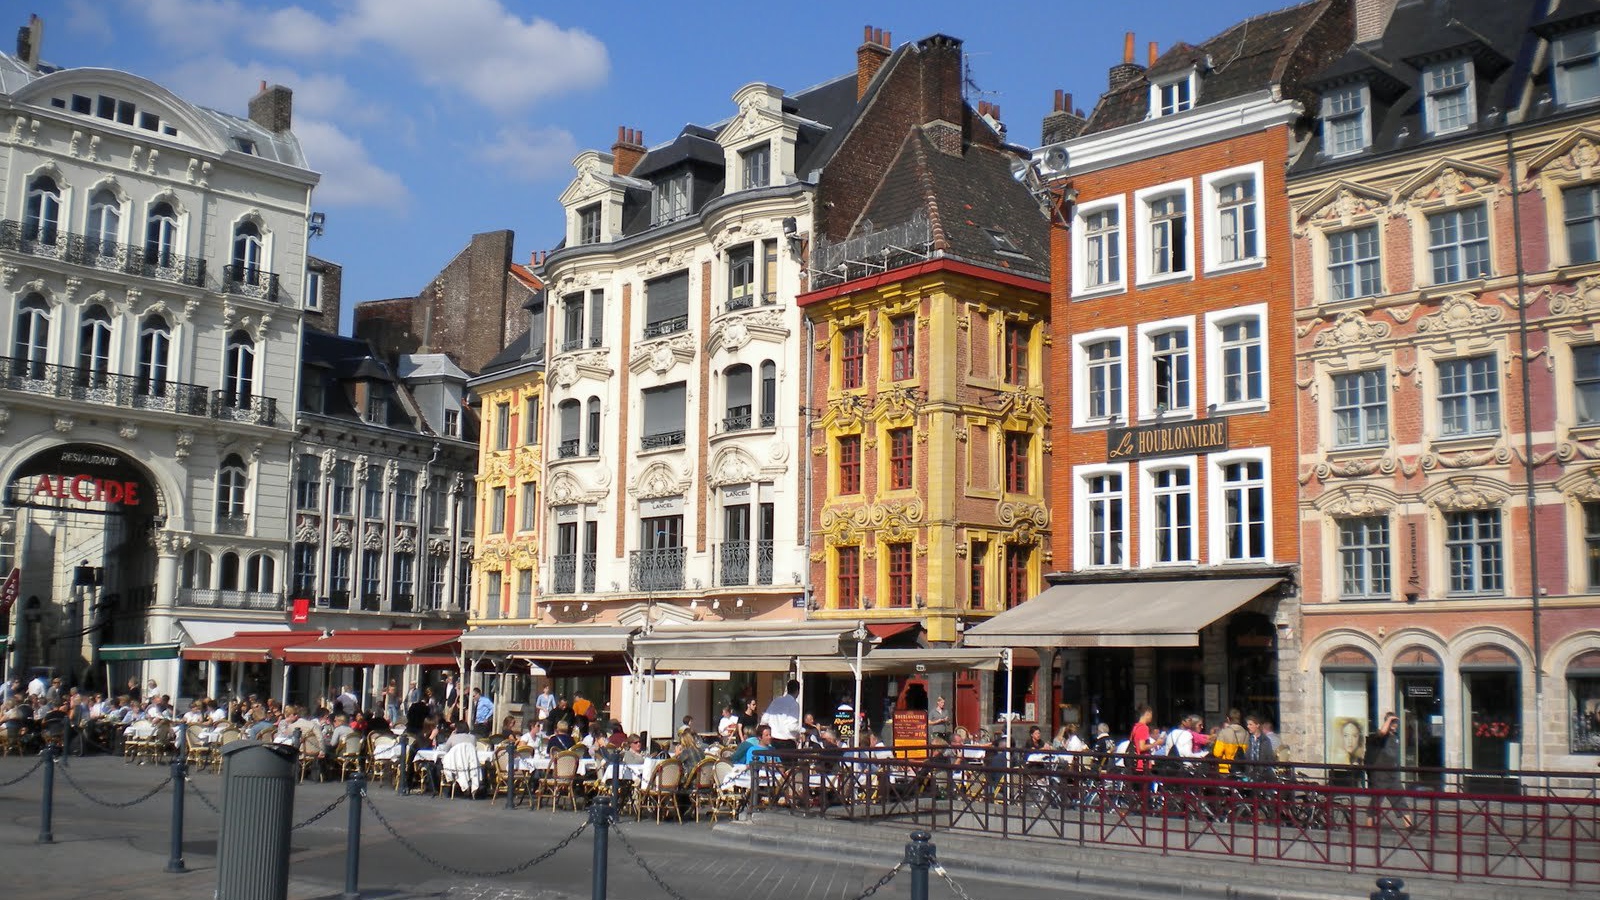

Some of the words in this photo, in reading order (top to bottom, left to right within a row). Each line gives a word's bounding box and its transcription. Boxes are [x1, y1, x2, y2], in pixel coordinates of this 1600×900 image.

[1110, 431, 1134, 458] La
[1138, 422, 1225, 454] HOUBLONNIERE
[61, 452, 117, 466] RESTAURANT
[33, 474, 139, 505] ALCIDE
[725, 490, 750, 498] LANCEL
[653, 502, 674, 510] LANCEL
